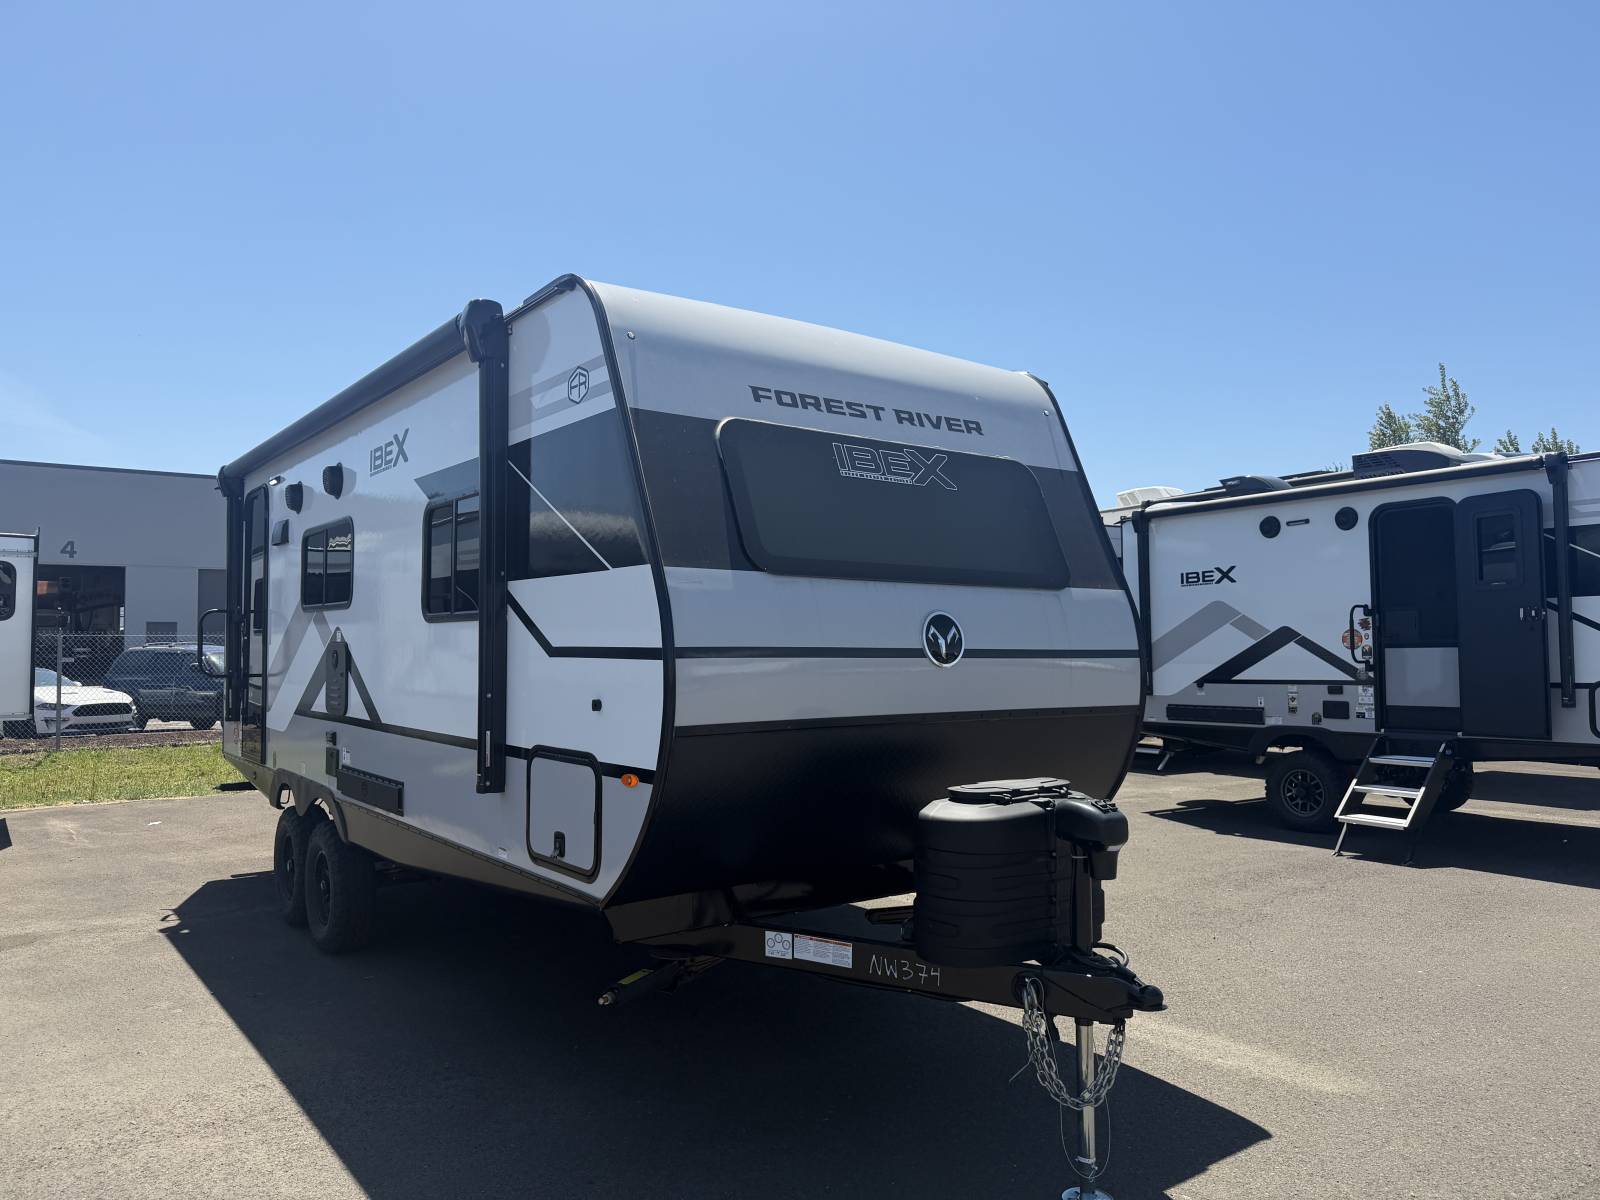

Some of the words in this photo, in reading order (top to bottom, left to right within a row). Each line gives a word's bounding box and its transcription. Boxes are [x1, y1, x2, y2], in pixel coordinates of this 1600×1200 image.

[748, 385, 885, 421] FOREST
[892, 408, 984, 436] RIVER
[369, 427, 410, 472] IBEX
[832, 442, 958, 491] IBEX
[60, 540, 78, 558] 4
[1180, 565, 1237, 584] IBEX
[869, 954, 941, 986] NW374
